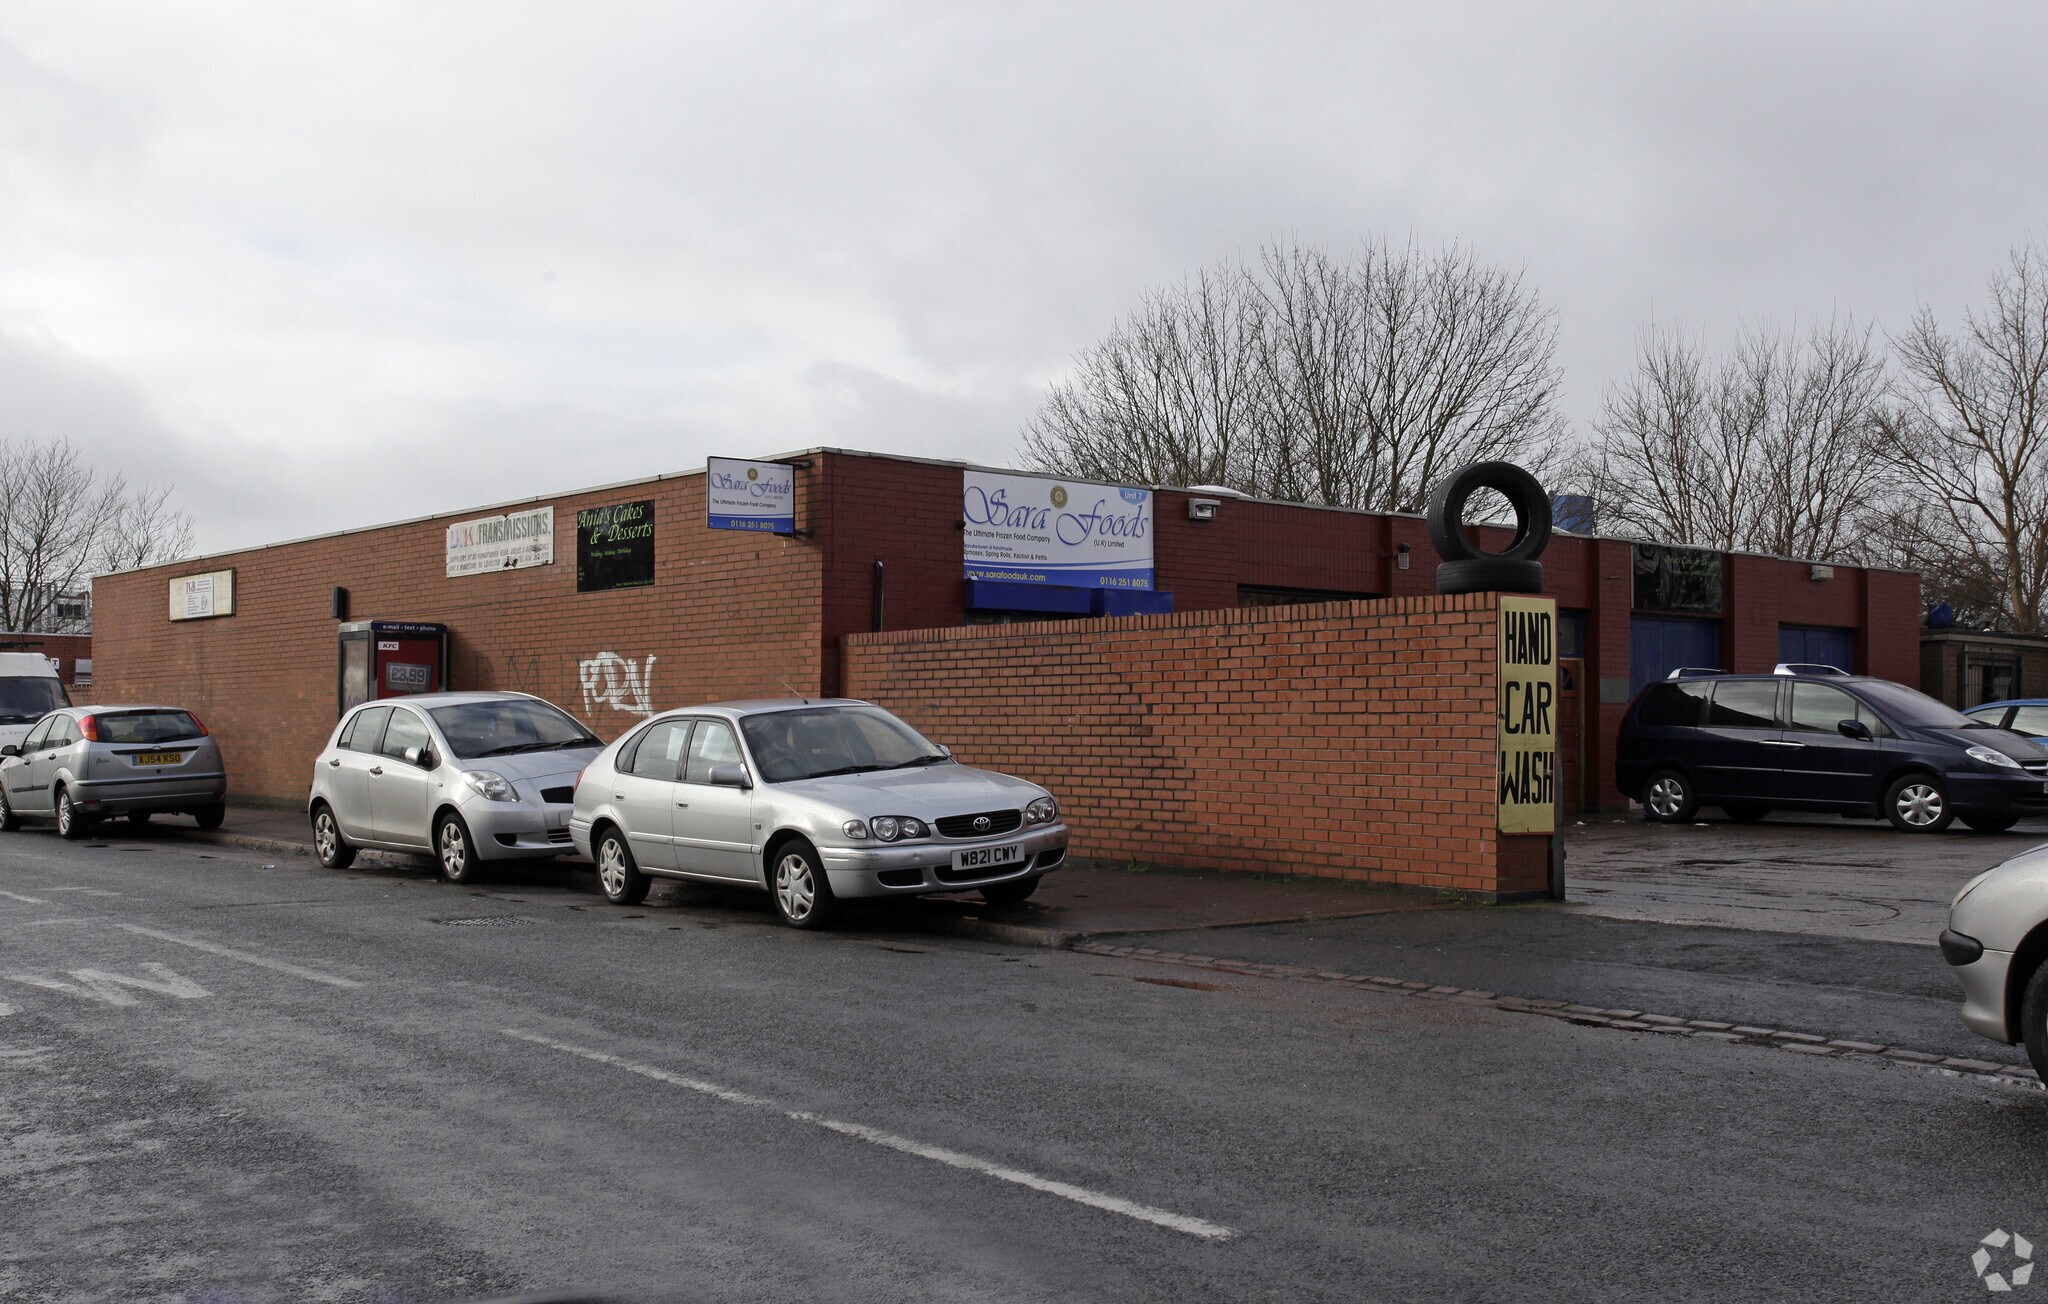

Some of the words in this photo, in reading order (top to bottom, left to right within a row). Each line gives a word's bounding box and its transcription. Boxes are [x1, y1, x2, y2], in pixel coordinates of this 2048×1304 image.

[711, 472, 750, 490] Sara
[750, 477, 792, 498] Foods
[1124, 492, 1137, 500] Unit
[1138, 492, 1143, 500] 7
[613, 503, 645, 523] Cakes
[964, 486, 1051, 530] Sara
[1056, 499, 1149, 546] Foods
[590, 526, 603, 545] &
[608, 522, 653, 542] Desserts
[730, 519, 746, 528] 0116
[747, 521, 758, 529] 251
[760, 522, 775, 530] 8075
[964, 528, 972, 537] The
[974, 529, 995, 538] Ultimate
[995, 531, 1013, 540] Frozen
[1013, 532, 1026, 541] Food
[1027, 534, 1051, 544] Company
[1107, 540, 1125, 548] Limited
[985, 550, 1000, 558] Spring
[1100, 576, 1117, 586] 0116
[1118, 577, 1131, 587] 251
[1132, 579, 1149, 588] 8075
[1505, 610, 1552, 665] HAND
[1504, 680, 1552, 735] CAR
[138, 754, 161, 765] AJ54
[163, 753, 181, 764] KSO
[1500, 751, 1554, 805] WASH
[961, 849, 991, 867] W821
[994, 845, 1018, 862] CWY
